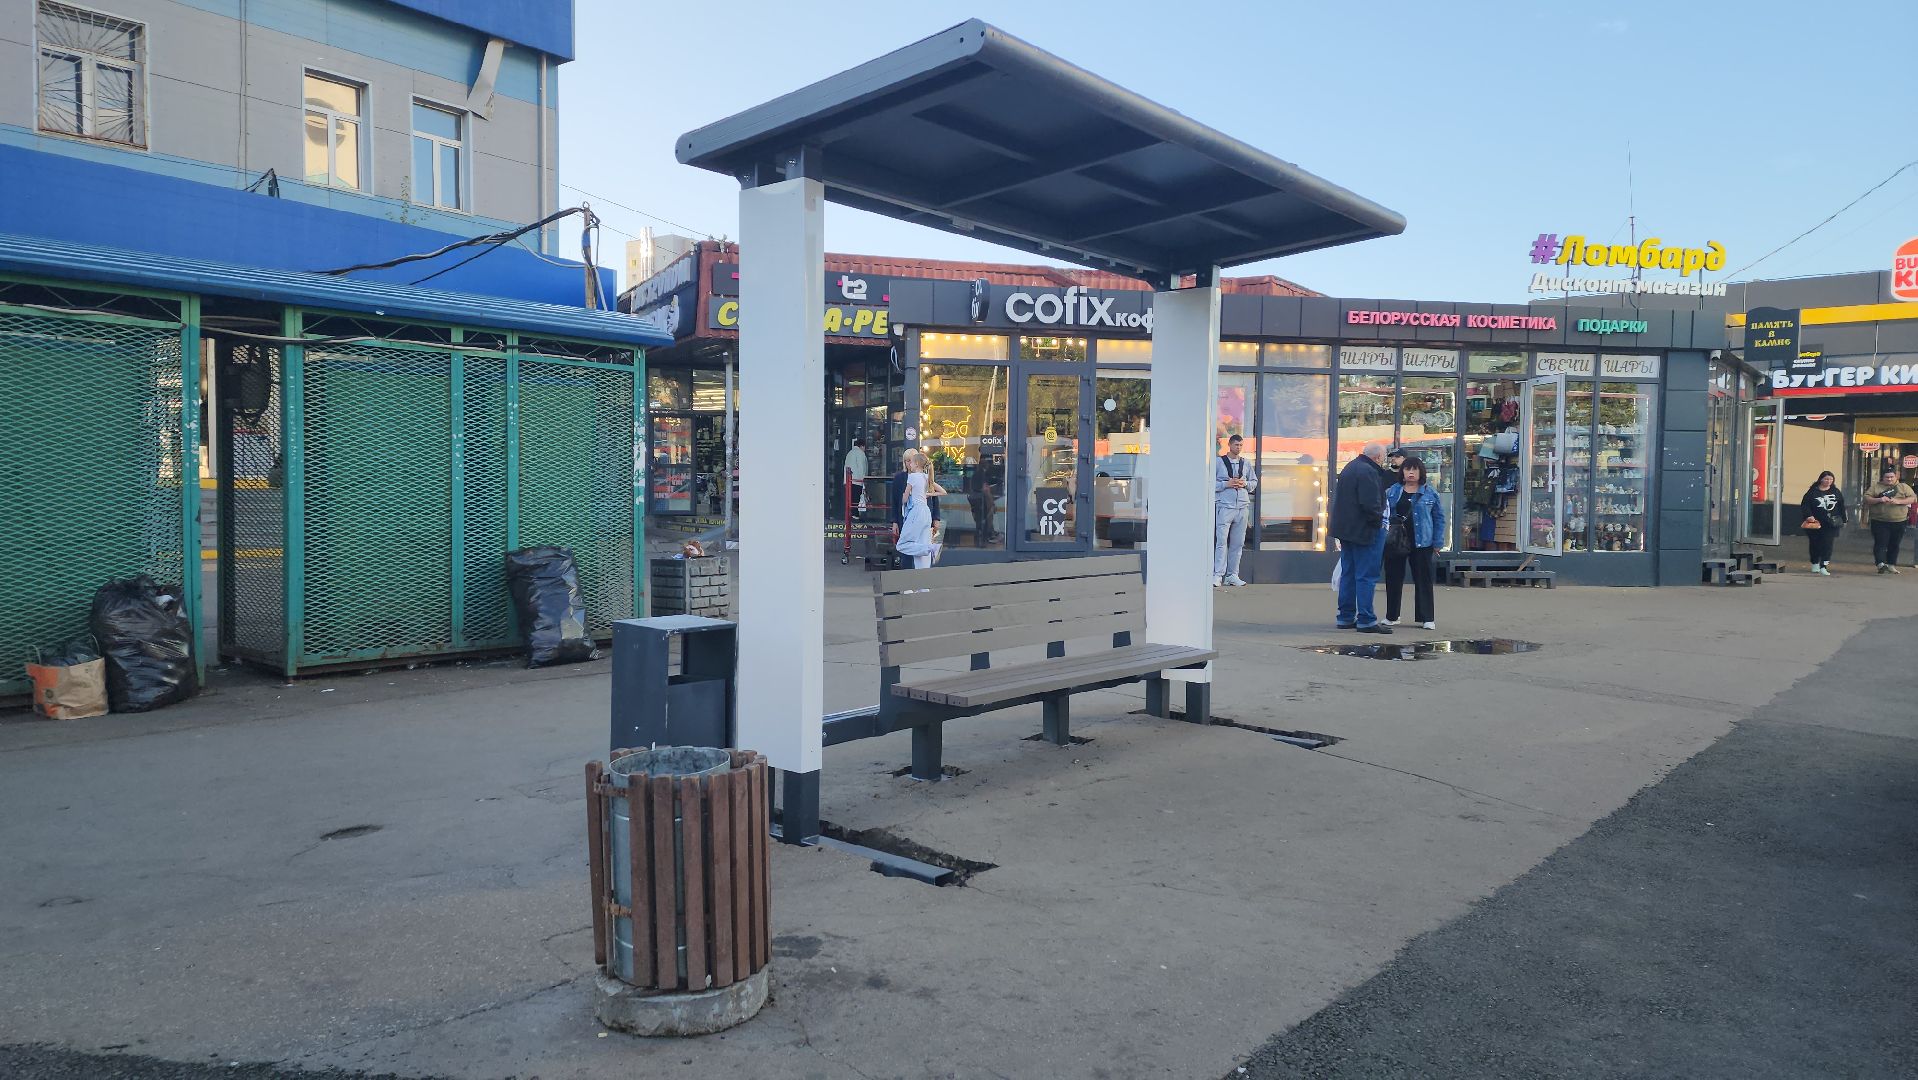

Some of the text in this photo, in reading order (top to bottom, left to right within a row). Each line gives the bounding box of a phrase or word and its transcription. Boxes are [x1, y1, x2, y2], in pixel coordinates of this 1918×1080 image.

[1529, 234, 1727, 277] #Ломбард
[1895, 258, 1918, 271] BU
[1528, 272, 1727, 297] Дисконт магазин
[1894, 271, 1918, 288] KI
[1005, 286, 1154, 334] cofix коф
[1347, 310, 1557, 331] БЕЛОРУССКАЯ КОСМЕТИКА
[1577, 318, 1648, 335] ПОДАРКИ
[1750, 320, 1794, 330] ПАМЯТЬ
[1754, 338, 1792, 348] КАМНЕ
[1340, 351, 1394, 367] ШАРЫ
[1403, 352, 1456, 369] ШАРЫ
[1537, 358, 1591, 374] СВЕЧИ
[1604, 358, 1654, 375] ШАРЫ
[1880, 364, 1918, 387] КИ
[982, 436, 1002, 445] cofix
[1040, 515, 1065, 536] fix
